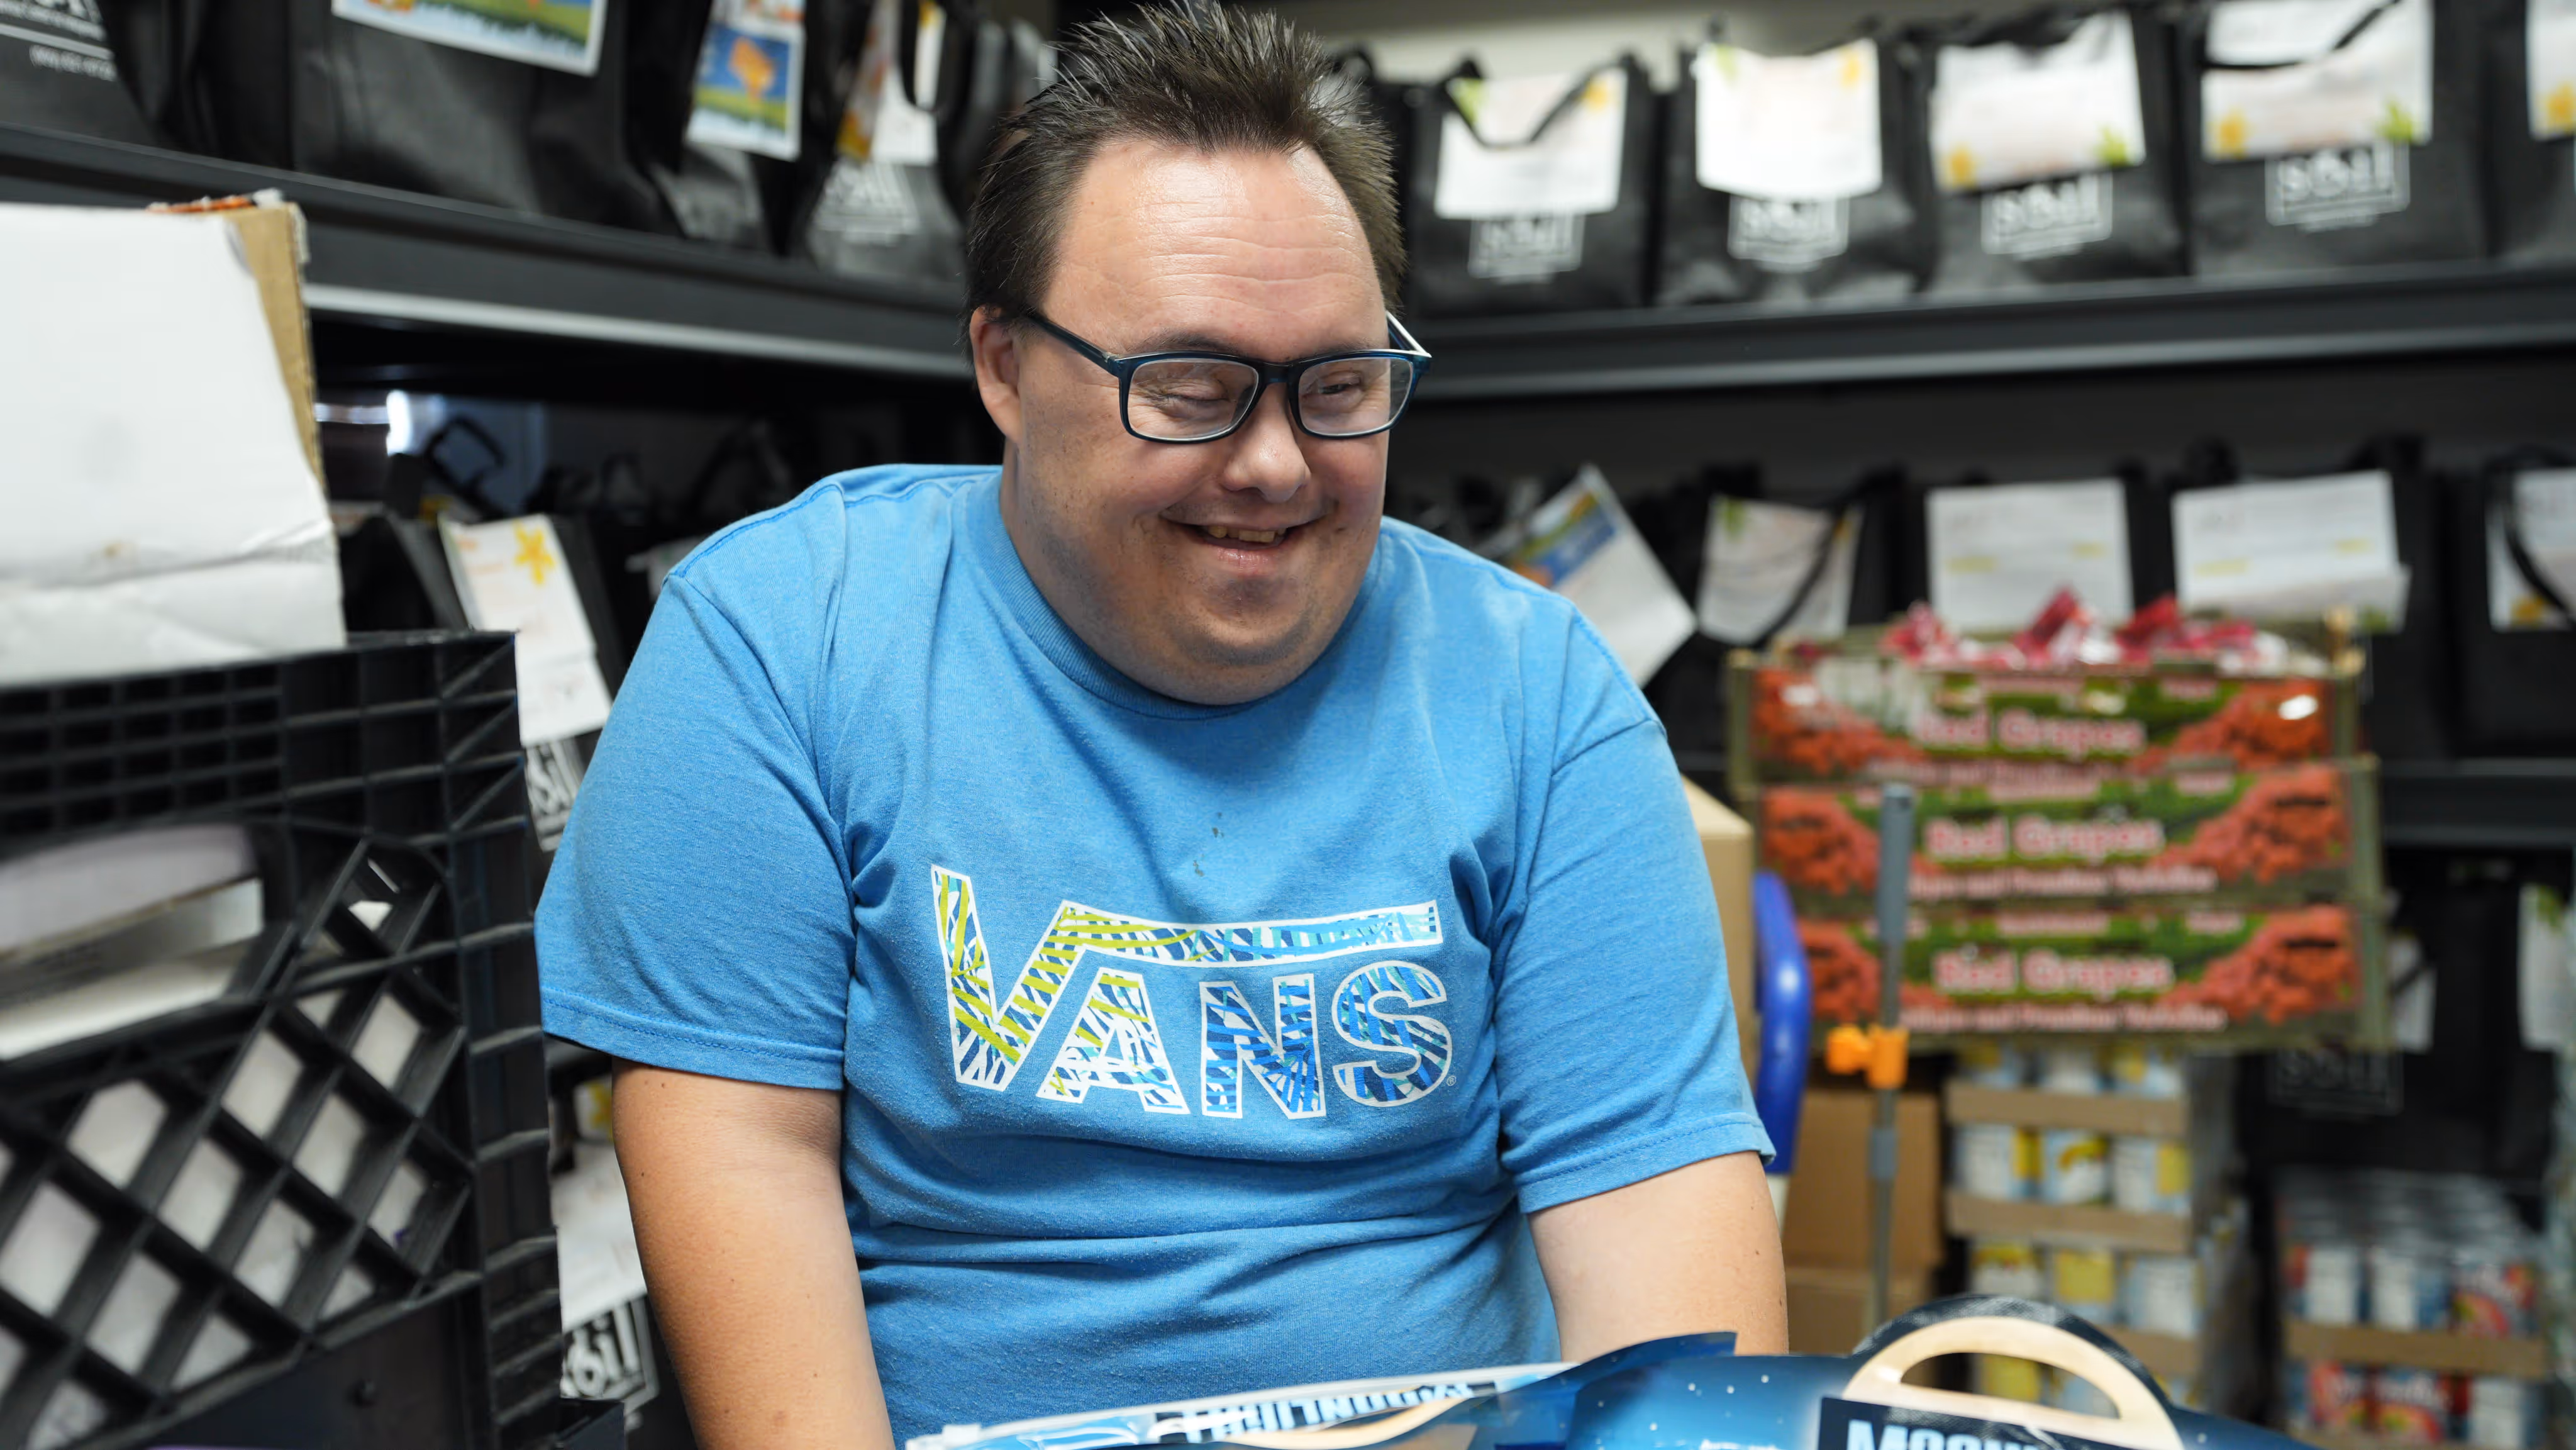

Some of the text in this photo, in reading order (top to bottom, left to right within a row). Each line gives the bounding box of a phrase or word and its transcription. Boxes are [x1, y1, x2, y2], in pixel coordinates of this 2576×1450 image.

[1997, 710, 2147, 761] Grapes
[1926, 813, 2167, 866] Red Grapes
[931, 864, 1453, 1120] VANS
[1933, 948, 2175, 1001] Red Grapes
